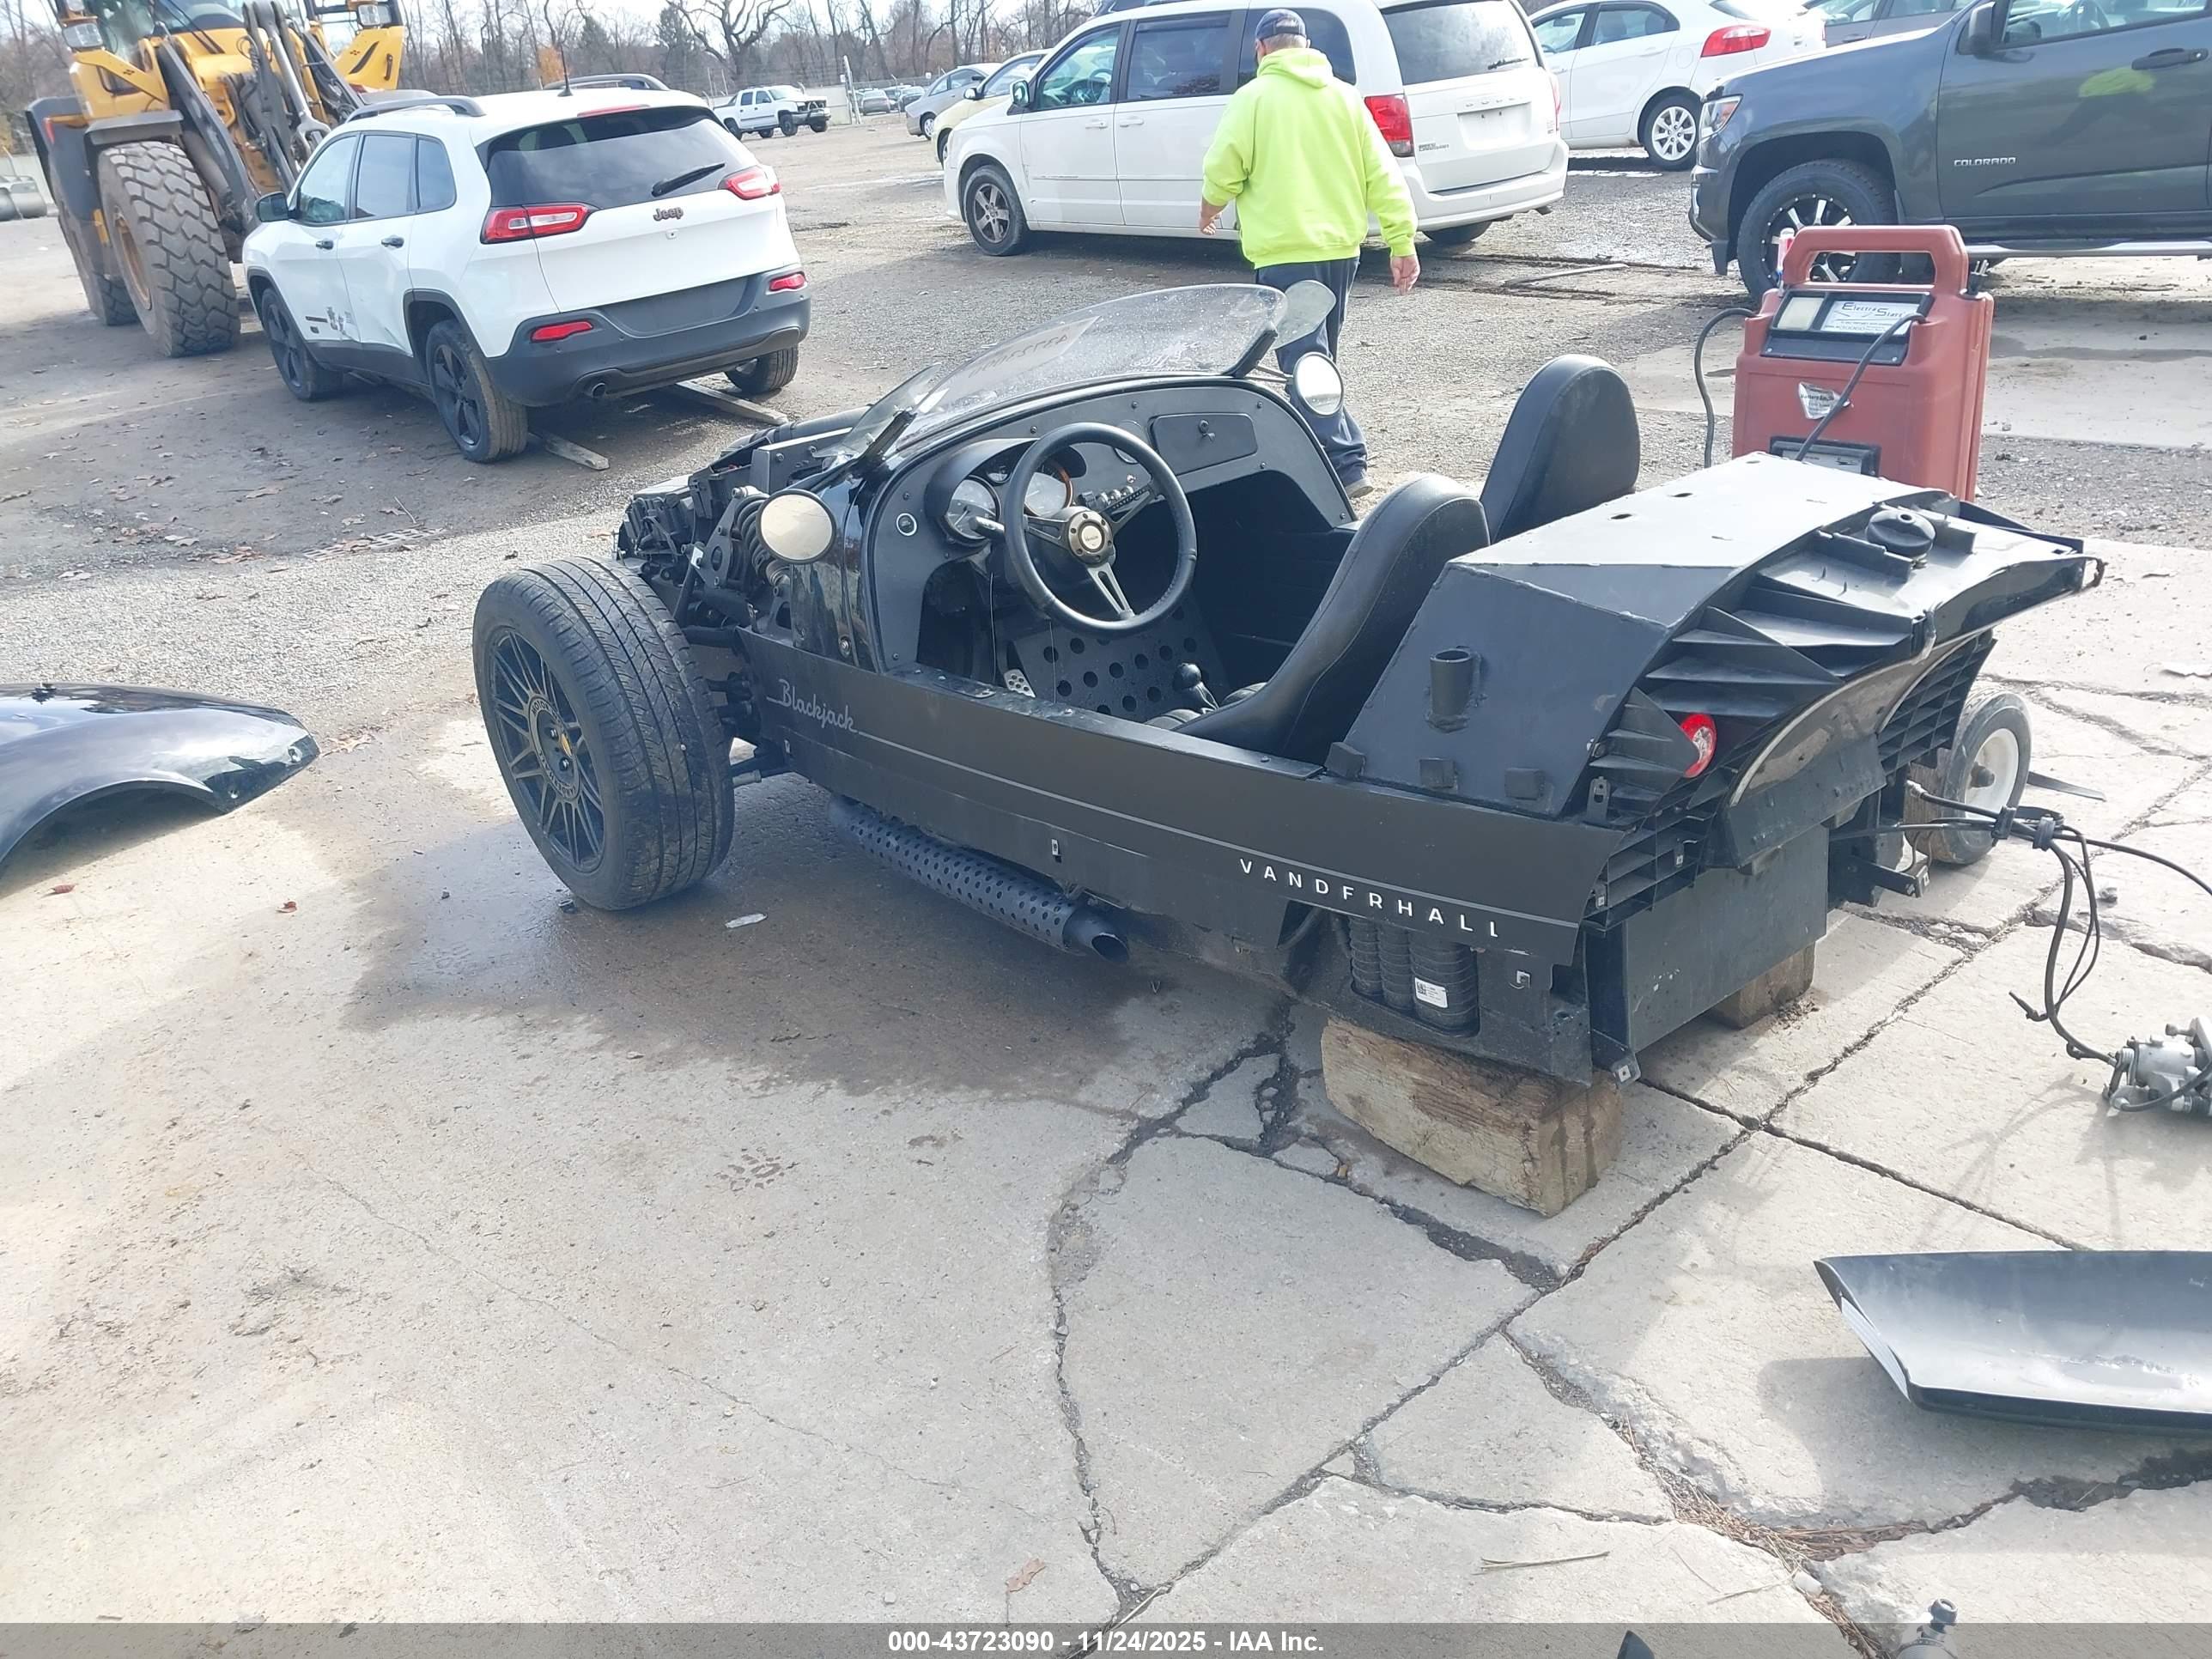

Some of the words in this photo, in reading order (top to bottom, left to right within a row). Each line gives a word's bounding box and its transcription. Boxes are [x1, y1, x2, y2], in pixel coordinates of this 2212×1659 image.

[1954, 157, 2016, 166] COLORADO
[653, 207, 684, 222] Jeep
[777, 678, 858, 732] Blackjack
